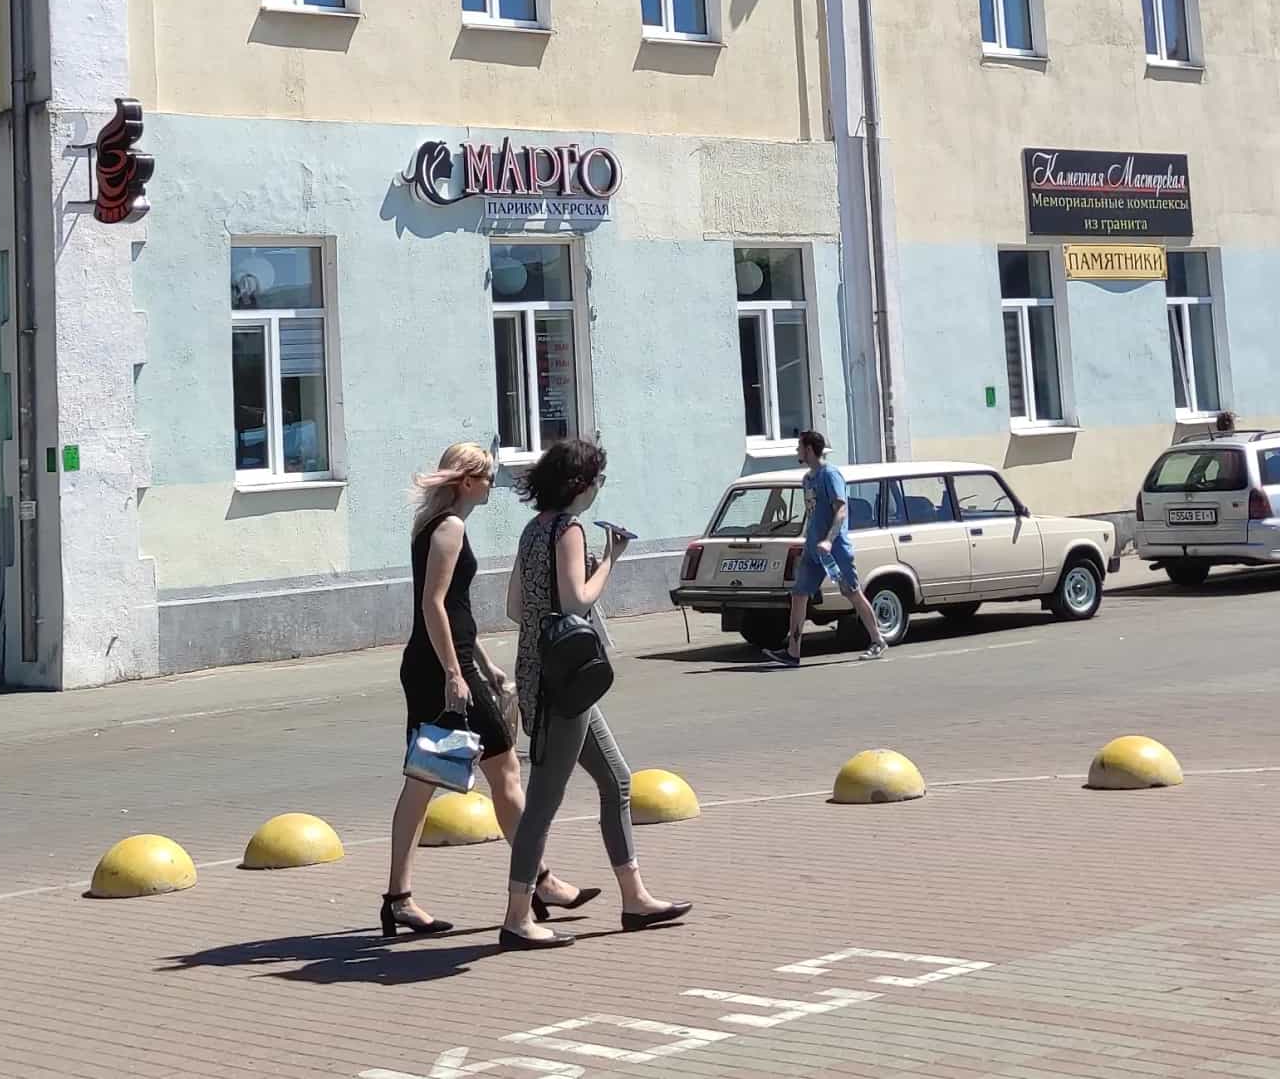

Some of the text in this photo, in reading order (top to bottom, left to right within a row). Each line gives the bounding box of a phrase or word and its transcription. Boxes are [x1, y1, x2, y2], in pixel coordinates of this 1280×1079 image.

[461, 136, 623, 199] МАРГО
[1031, 152, 1185, 197] Каменная Мастерская
[487, 200, 609, 217] ПАРИКМАХЕРСКАЯ
[1031, 193, 1189, 211] Мемориальные комплексы
[1084, 218, 1148, 234] из гранита
[1068, 252, 1162, 271] ПАМЯТНИКИ
